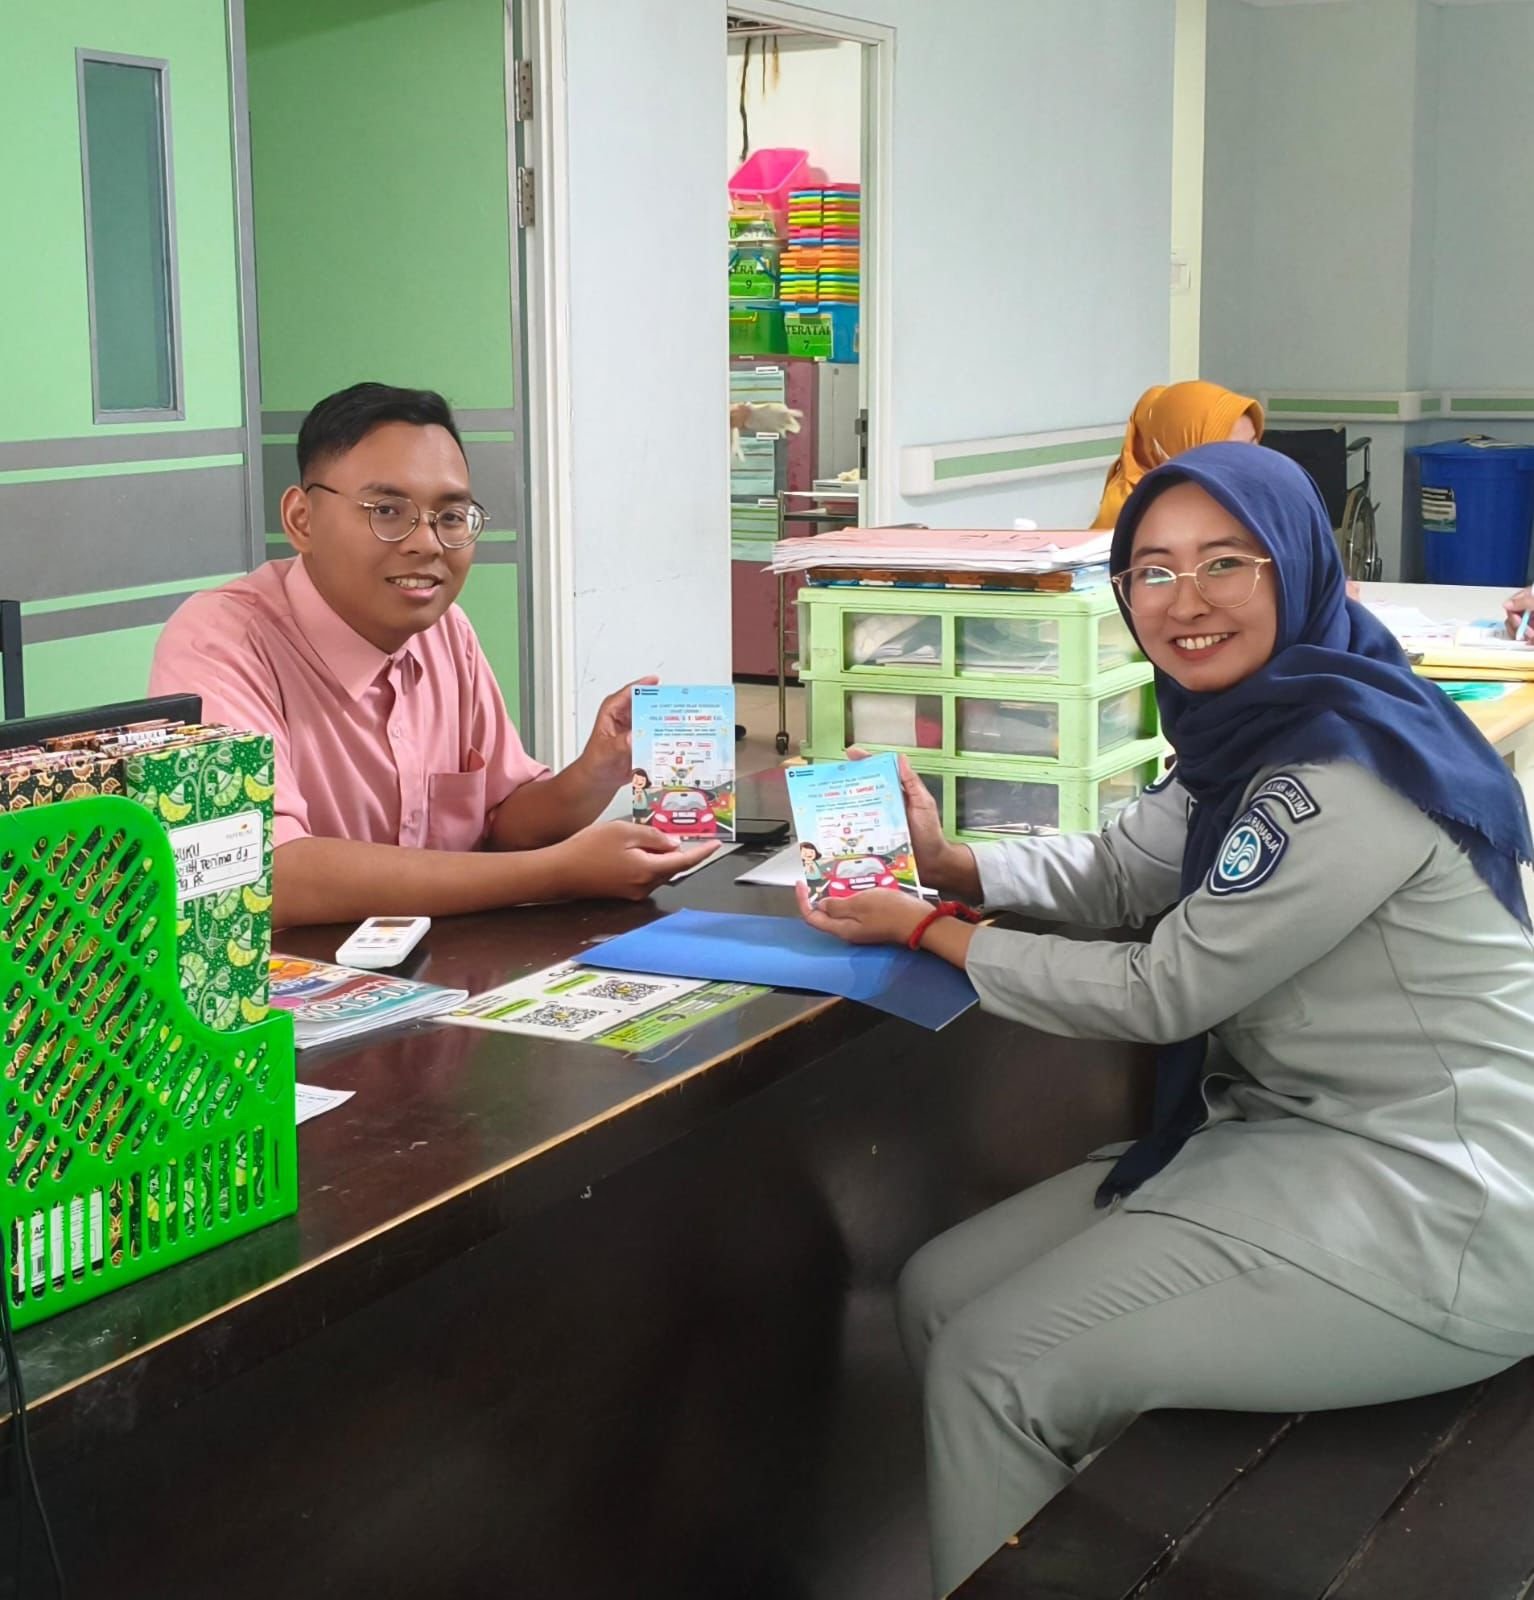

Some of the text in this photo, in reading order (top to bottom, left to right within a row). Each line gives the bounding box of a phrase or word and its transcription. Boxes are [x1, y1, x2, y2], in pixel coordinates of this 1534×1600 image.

[745, 279, 753, 290] 9
[803, 340, 809, 350] 7
[1285, 788, 1308, 813] JATIM
